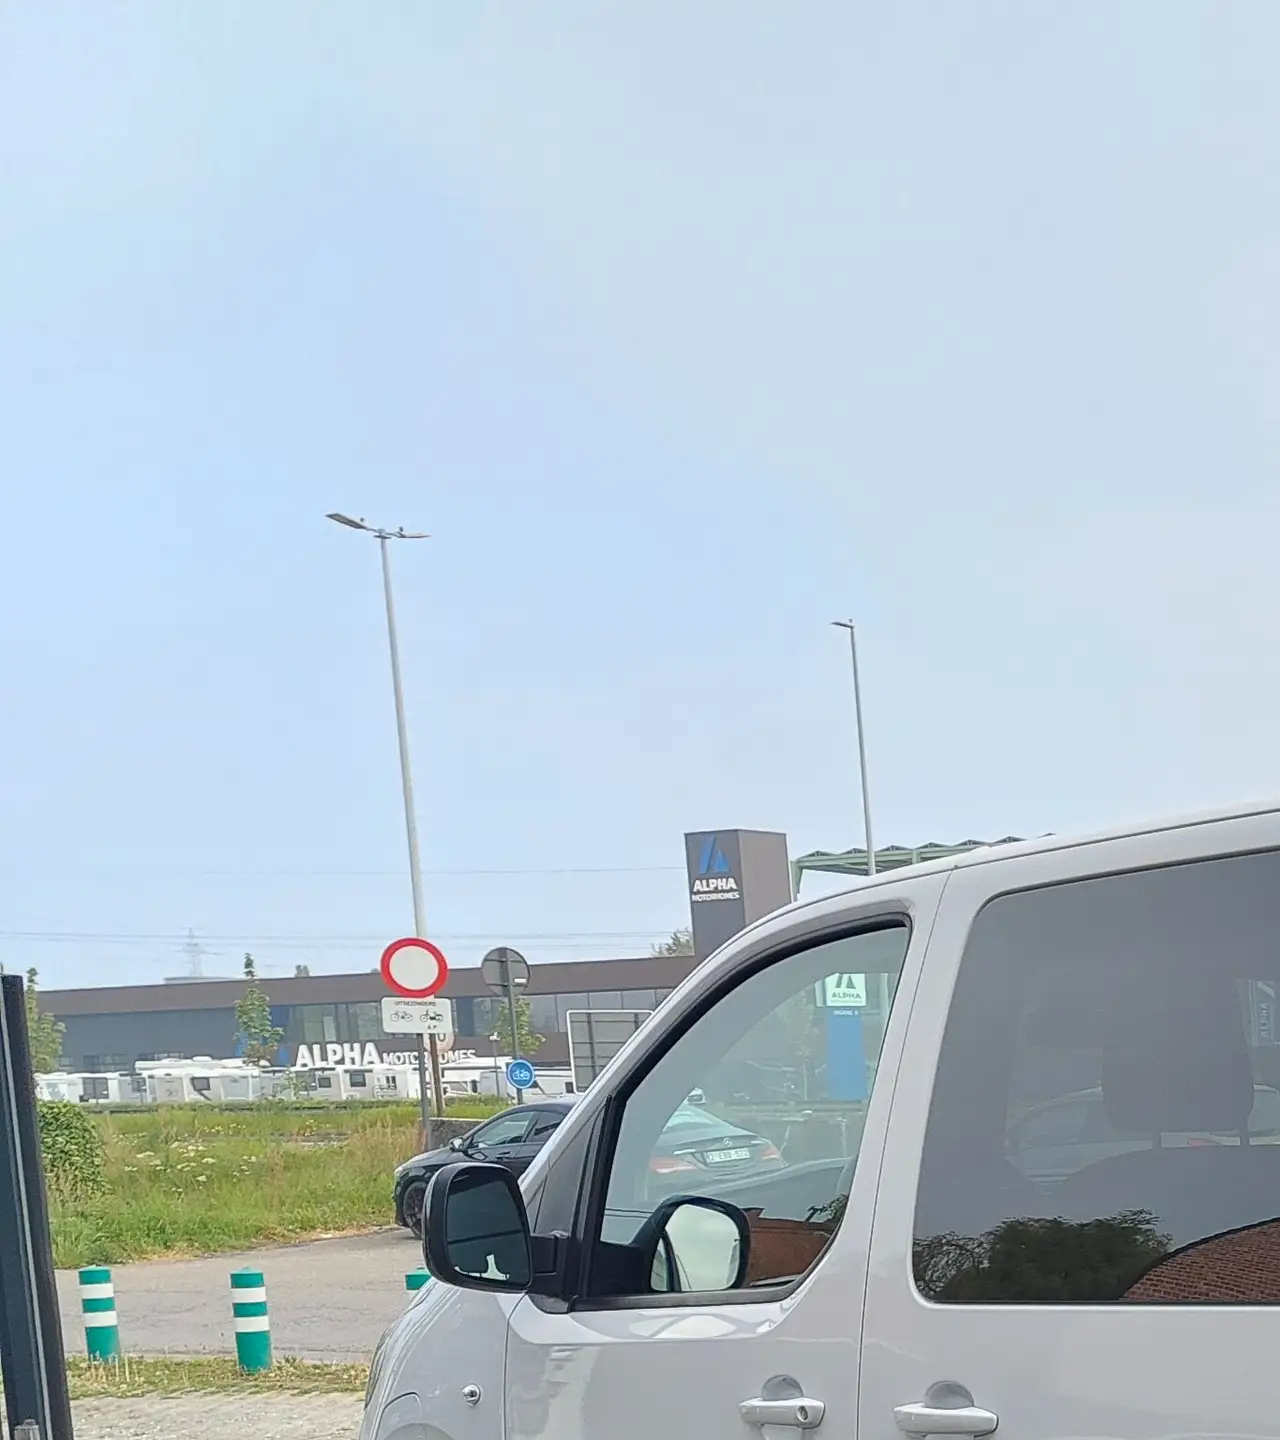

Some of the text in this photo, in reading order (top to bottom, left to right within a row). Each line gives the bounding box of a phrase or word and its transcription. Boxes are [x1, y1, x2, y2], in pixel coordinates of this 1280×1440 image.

[693, 877, 738, 892] ALPHA
[831, 991, 862, 1000] ALPHA
[296, 1042, 382, 1068] ALPHA
